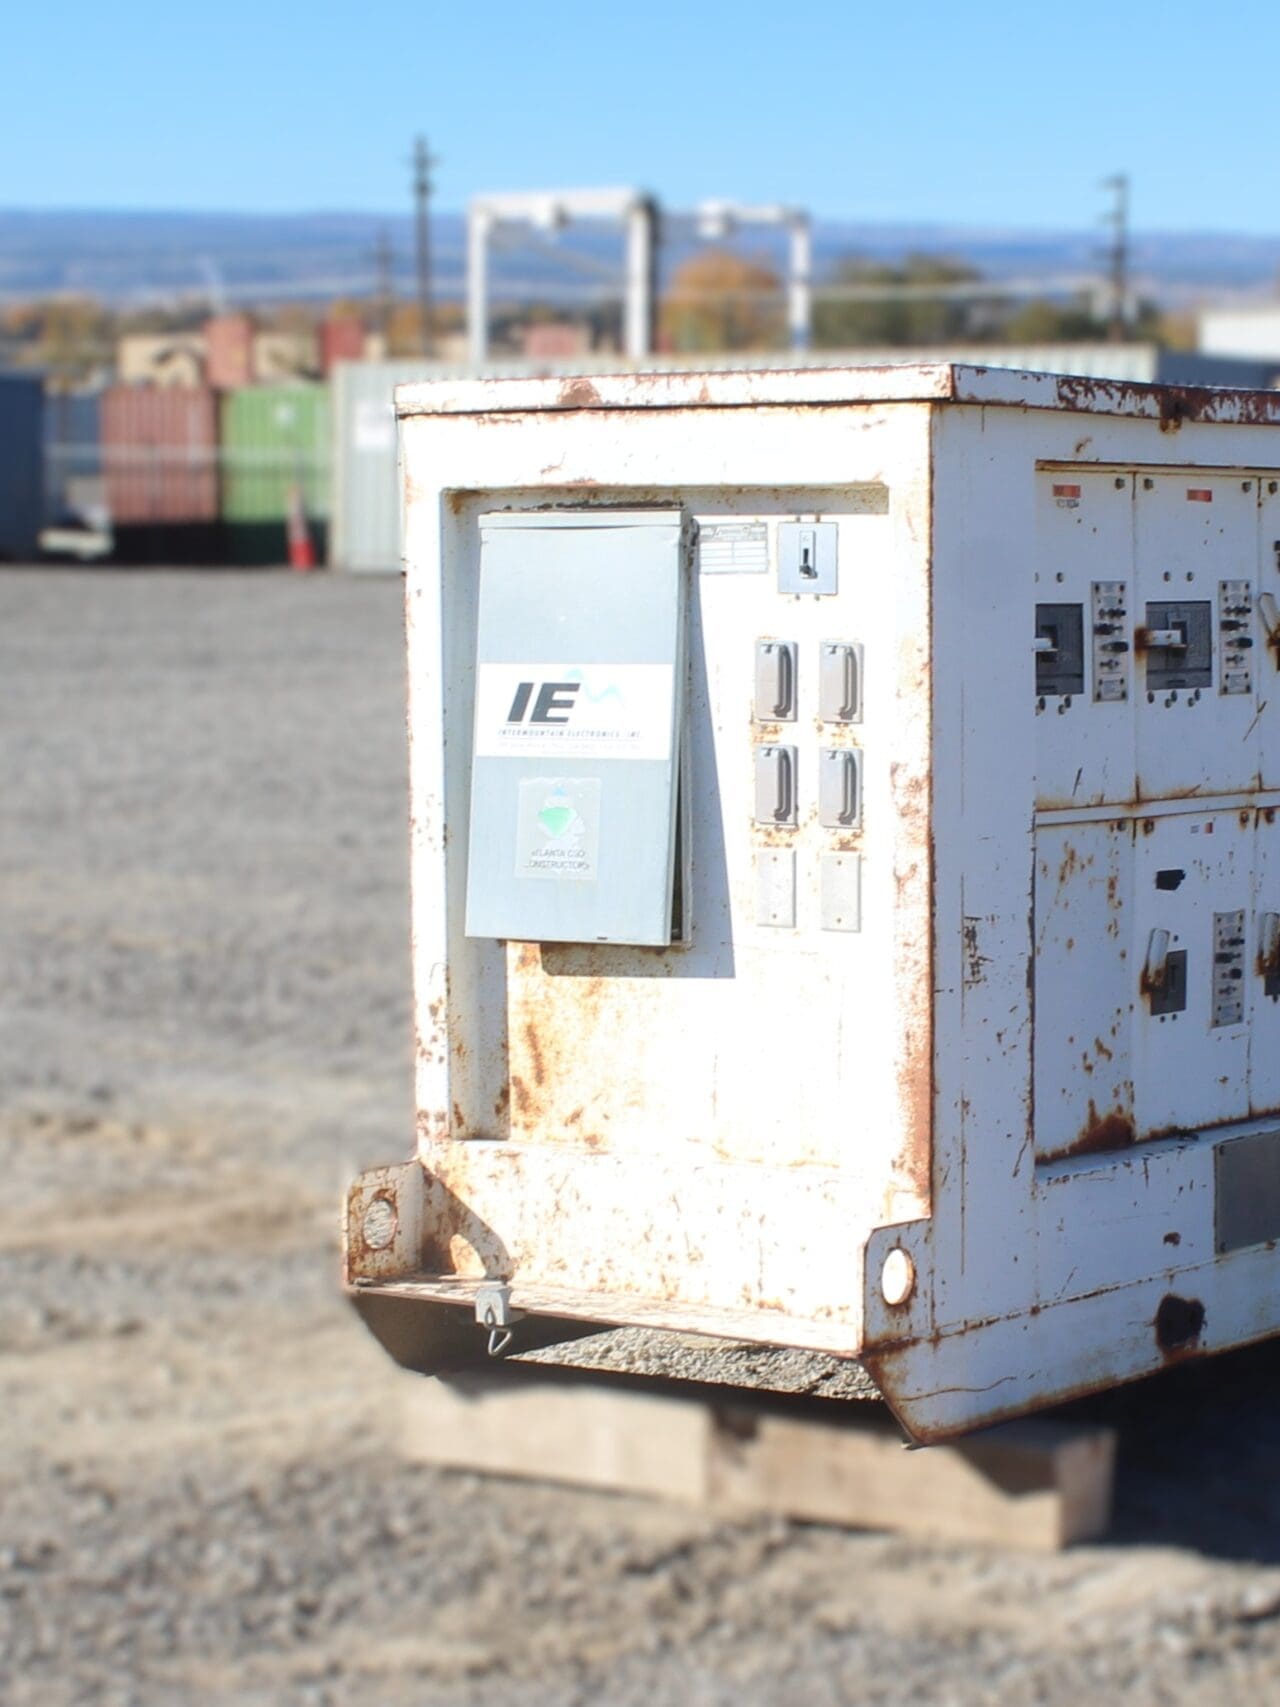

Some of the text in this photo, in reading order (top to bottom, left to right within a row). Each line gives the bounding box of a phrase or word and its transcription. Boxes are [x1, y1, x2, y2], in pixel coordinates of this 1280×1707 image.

[507, 682, 581, 723] IE
[498, 729, 565, 737] INTERMOUNTAIN
[523, 860, 590, 870] ONSTRUCTORS
